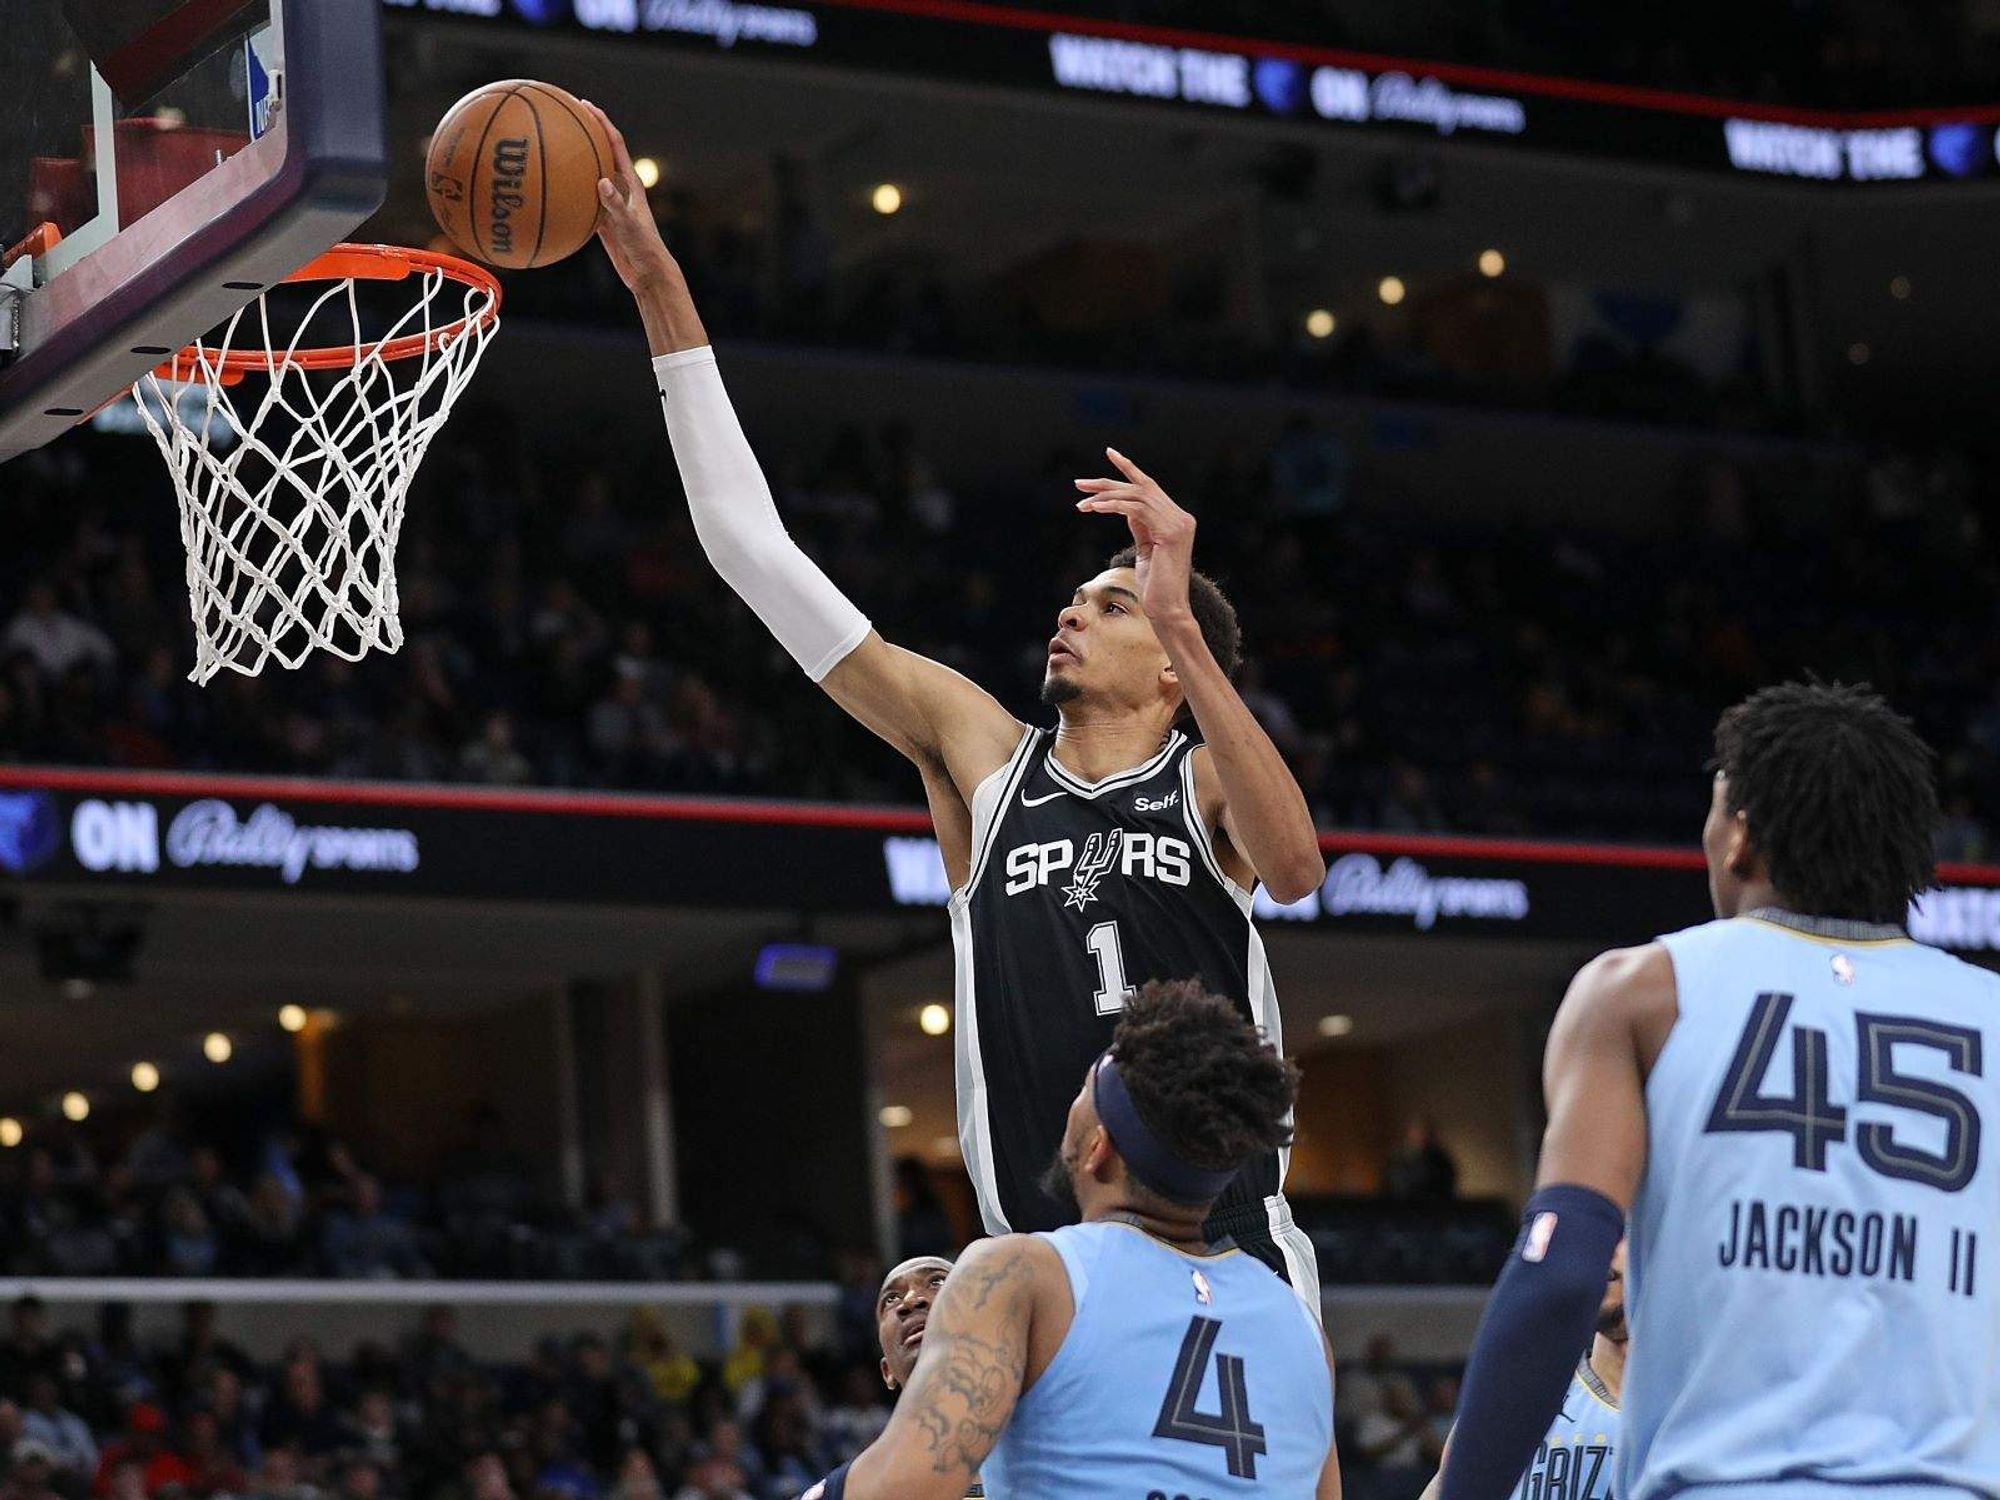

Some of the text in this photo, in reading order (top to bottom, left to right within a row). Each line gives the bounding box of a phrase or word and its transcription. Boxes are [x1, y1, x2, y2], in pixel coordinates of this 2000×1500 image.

[1312, 66, 1369, 121] ON
[493, 136, 529, 252] Wilson
[71, 800, 159, 874] ON
[1005, 828, 1190, 911] SPURS
[1086, 920, 1138, 1016] 1
[1705, 991, 1983, 1193] 45
[1718, 1200, 1977, 1297] JACKSON II
[1152, 1313, 1267, 1480] 4
[1519, 1444, 1613, 1500] GRIZ
